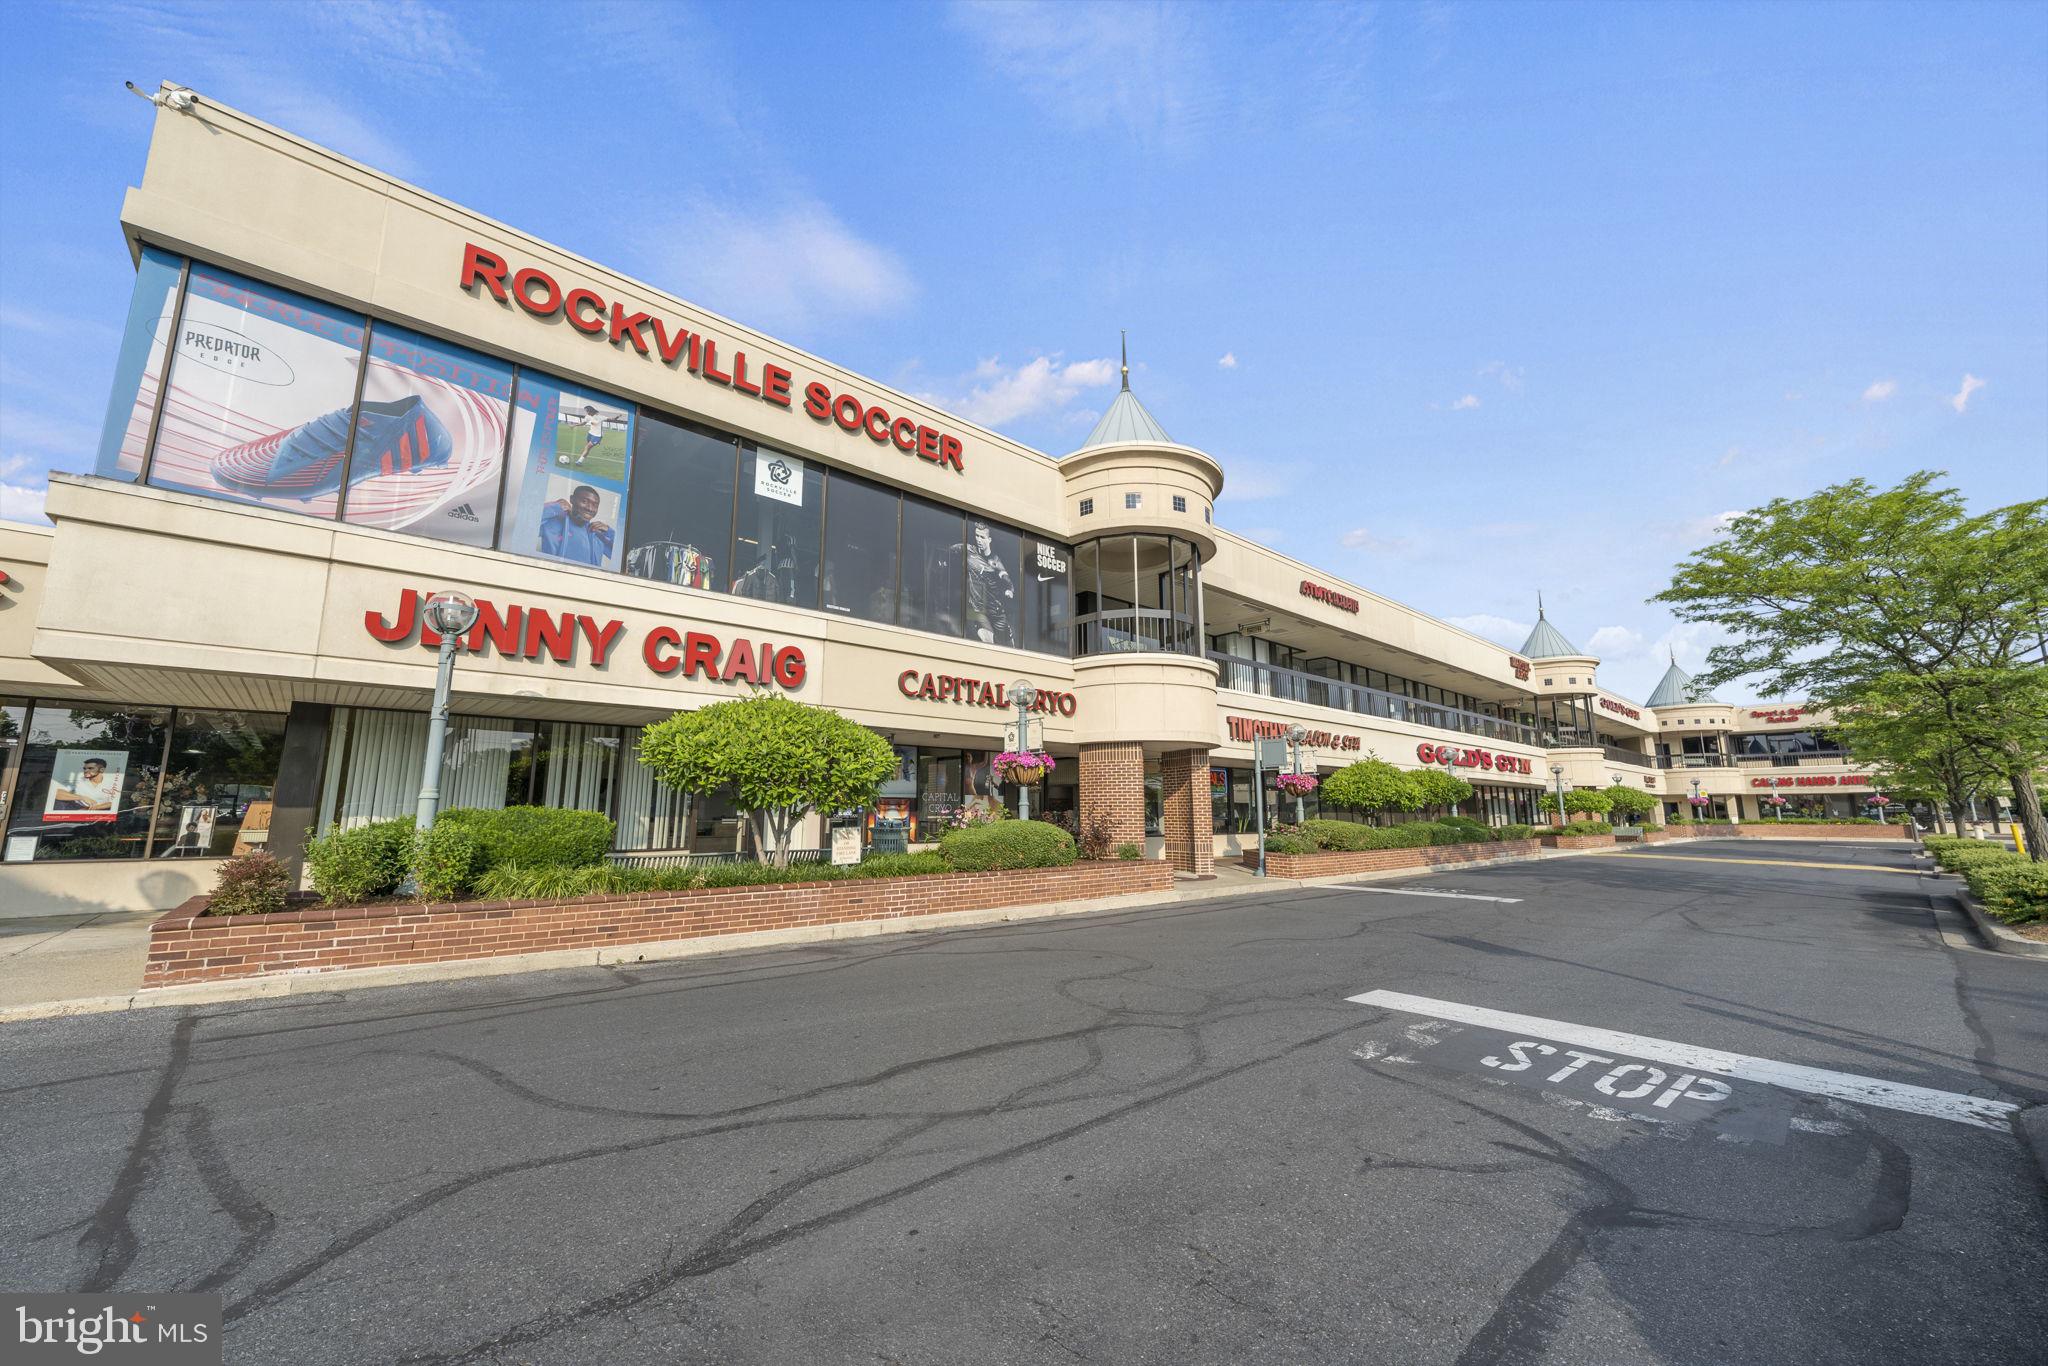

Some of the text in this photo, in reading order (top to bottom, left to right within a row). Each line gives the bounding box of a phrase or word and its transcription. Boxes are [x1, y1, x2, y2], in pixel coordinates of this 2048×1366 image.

[185, 331, 261, 362] PREDATOR
[200, 353, 245, 368] EDGE
[460, 242, 964, 472] ROCKVILLE SOCCER
[760, 480, 797, 494] ROCKVILLE
[766, 487, 791, 498] SOCCER
[448, 510, 479, 523] adidas
[1037, 542, 1055, 559] NIKE
[1037, 554, 1066, 573] SOCCER
[642, 626, 807, 688] CRAIG
[898, 670, 1077, 717] CAPITAL RYO
[1416, 743, 1533, 775] GOLD'S GYM
[922, 793, 959, 802] CAPITAL
[928, 803, 953, 813] CRYO
[1480, 1041, 1732, 1108] STOP
